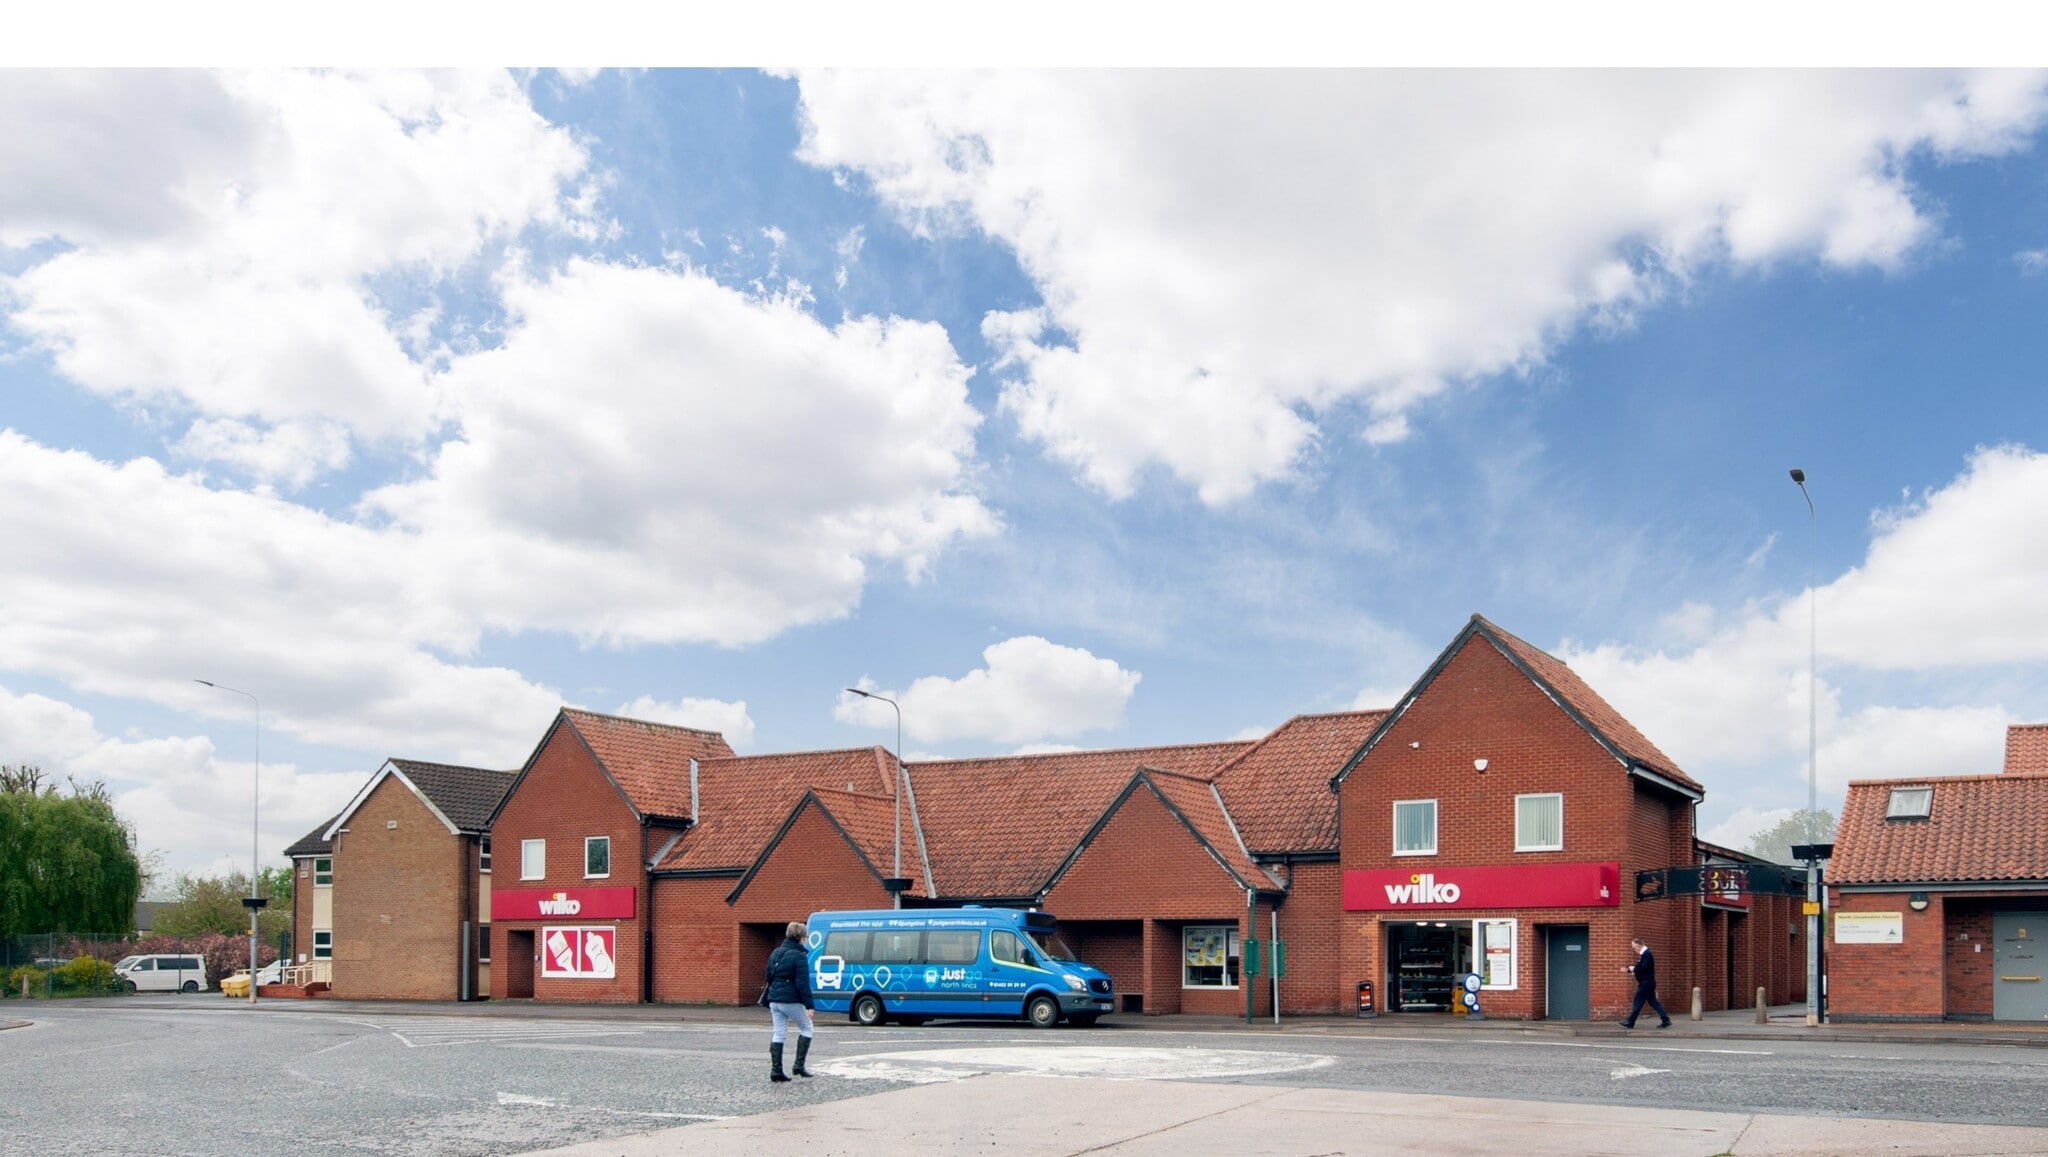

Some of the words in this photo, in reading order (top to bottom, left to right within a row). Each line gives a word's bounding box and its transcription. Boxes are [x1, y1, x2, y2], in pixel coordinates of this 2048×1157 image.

[1384, 873, 1461, 904] wilko
[538, 892, 581, 915] wilko
[830, 920, 859, 928] download
[872, 920, 883, 928] app
[961, 982, 977, 990] lincs
